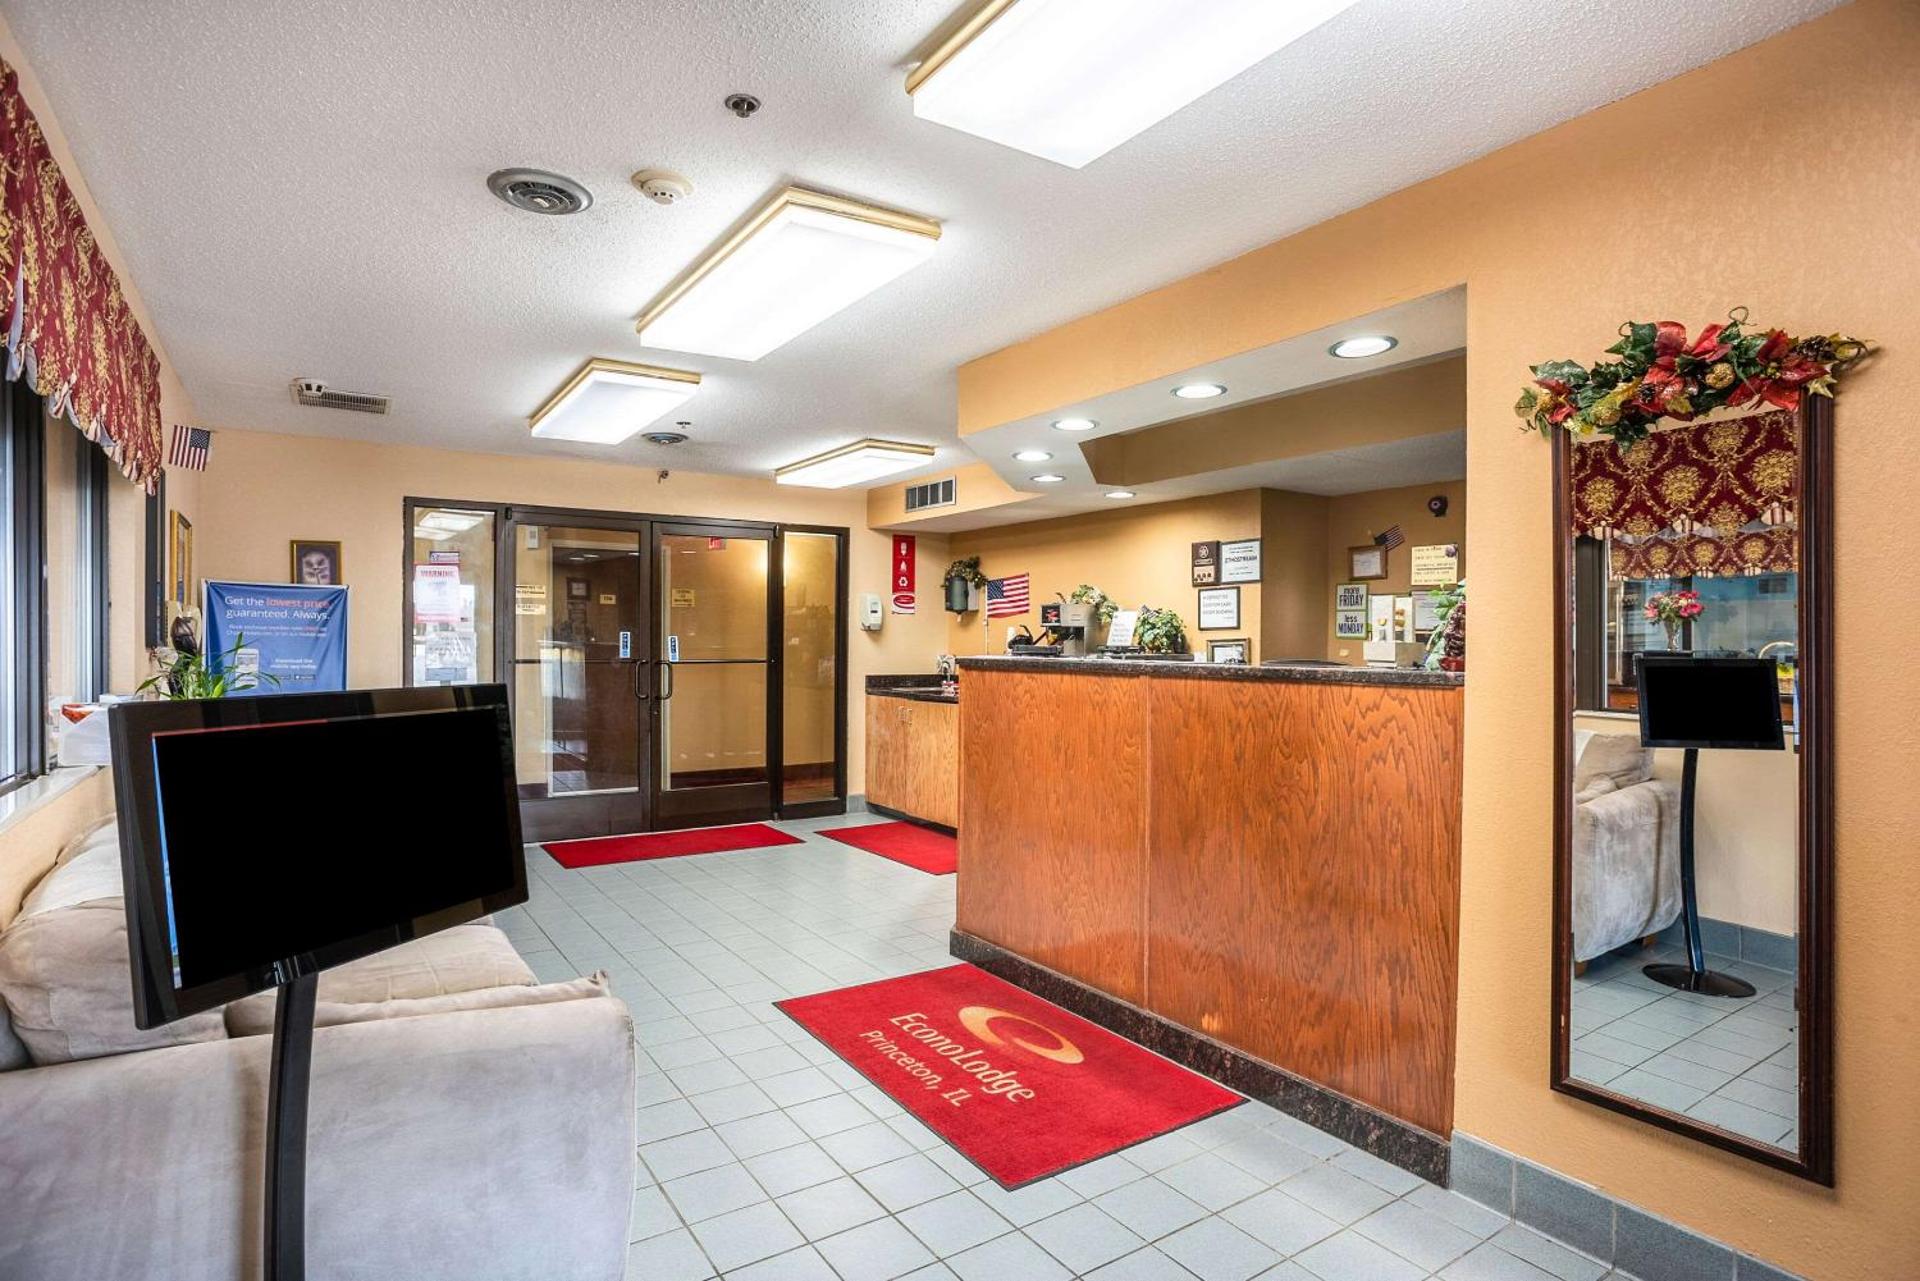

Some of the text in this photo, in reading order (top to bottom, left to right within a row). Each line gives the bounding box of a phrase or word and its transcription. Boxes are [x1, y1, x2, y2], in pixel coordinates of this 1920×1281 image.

[224, 596, 244, 606] Get
[246, 597, 264, 607] the
[266, 597, 302, 607] lowest
[1339, 594, 1364, 607] FRIDAY
[225, 608, 330, 621] guaranteed. Always.
[1344, 614, 1358, 622] less
[1338, 623, 1364, 634] MONDAY
[888, 1012, 1036, 1103] EconoLodge
[859, 1030, 973, 1107] Princeton, IL
